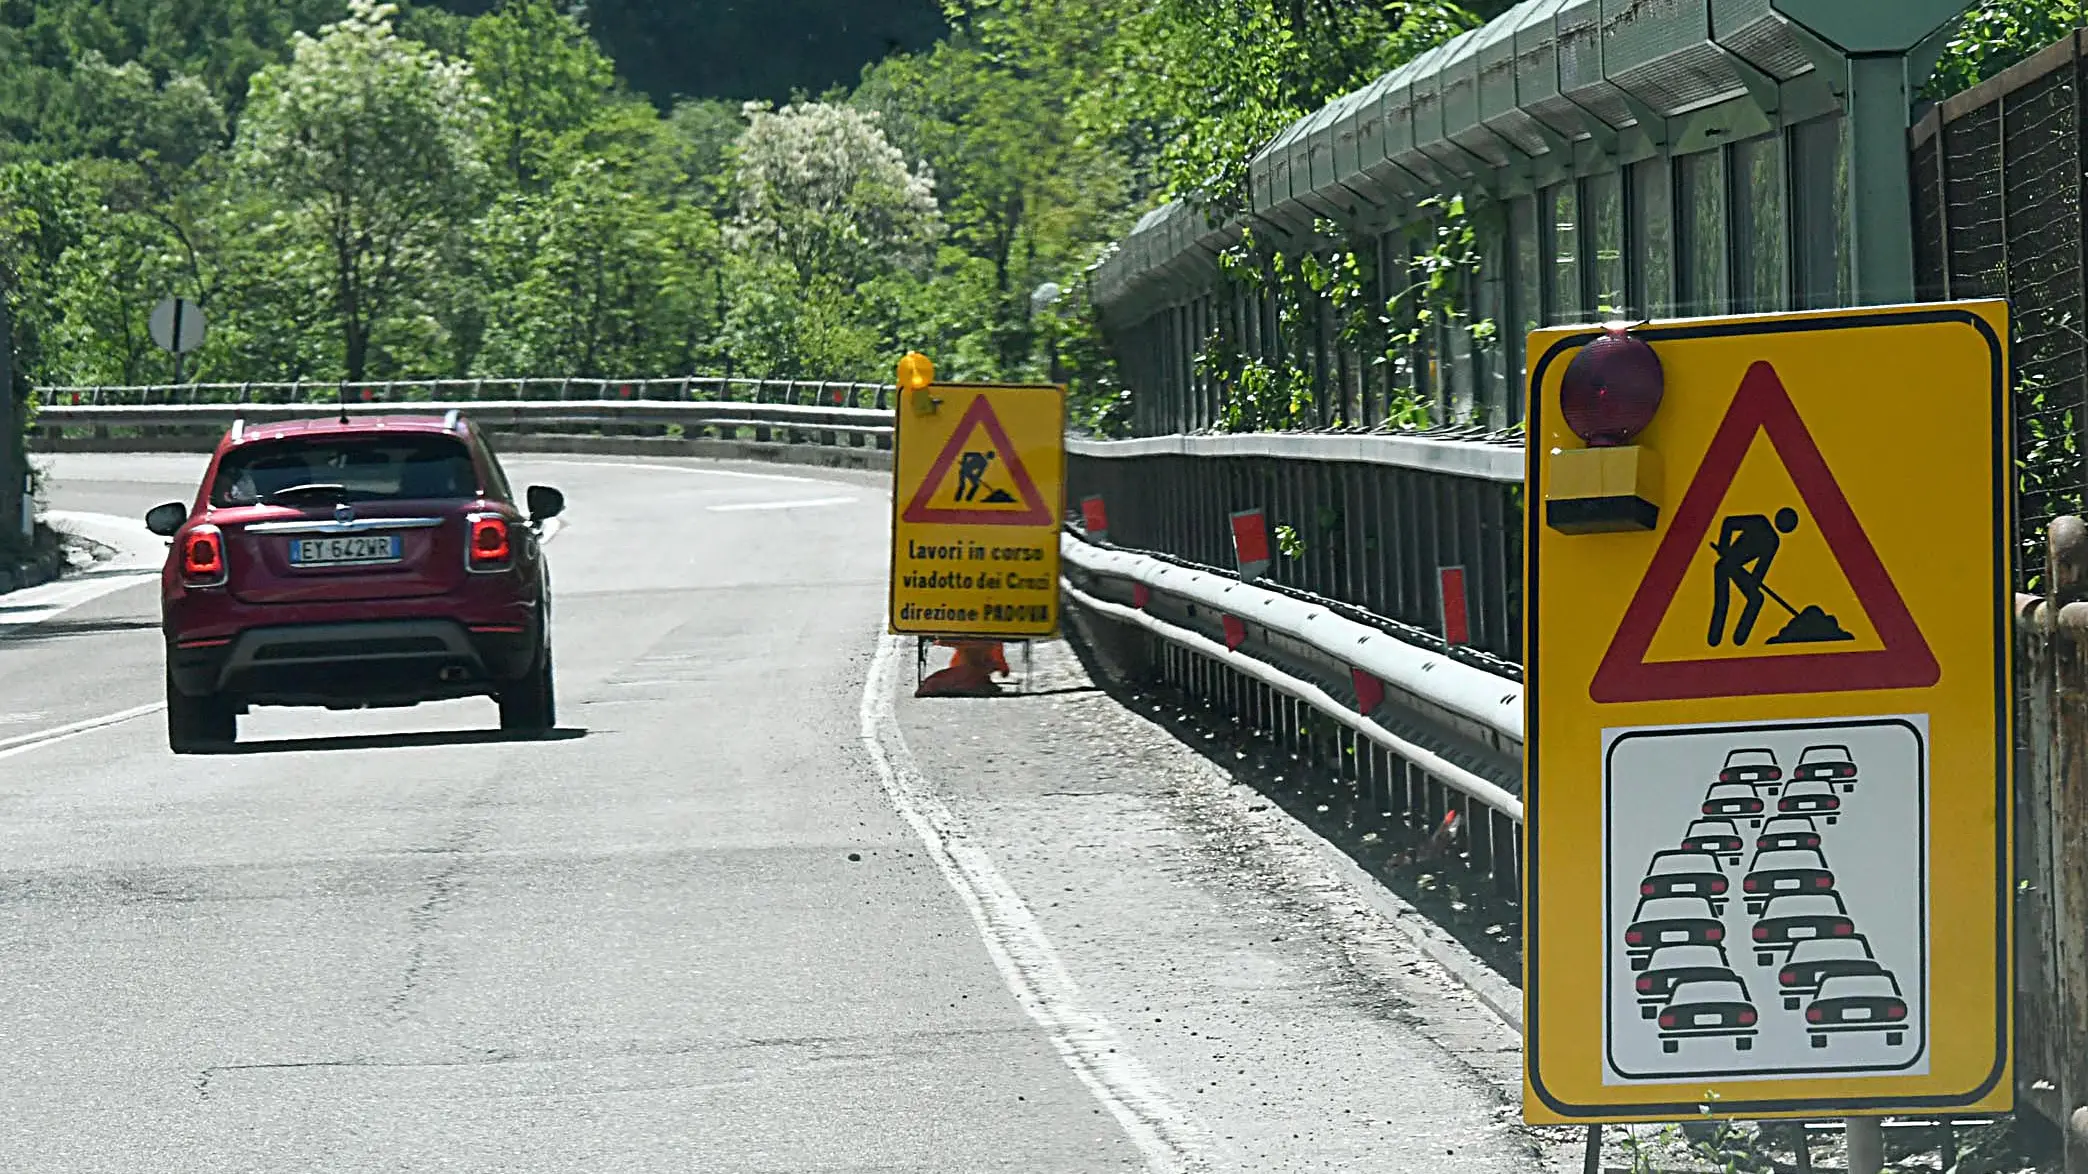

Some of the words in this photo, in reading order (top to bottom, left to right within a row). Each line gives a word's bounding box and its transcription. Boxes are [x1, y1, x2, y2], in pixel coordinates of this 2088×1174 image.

[302, 541, 324, 559] EY
[967, 541, 986, 560] in
[991, 546, 1044, 561] corso
[903, 570, 973, 589] viadotto
[976, 571, 1003, 589] dei
[900, 602, 978, 621] direzione
